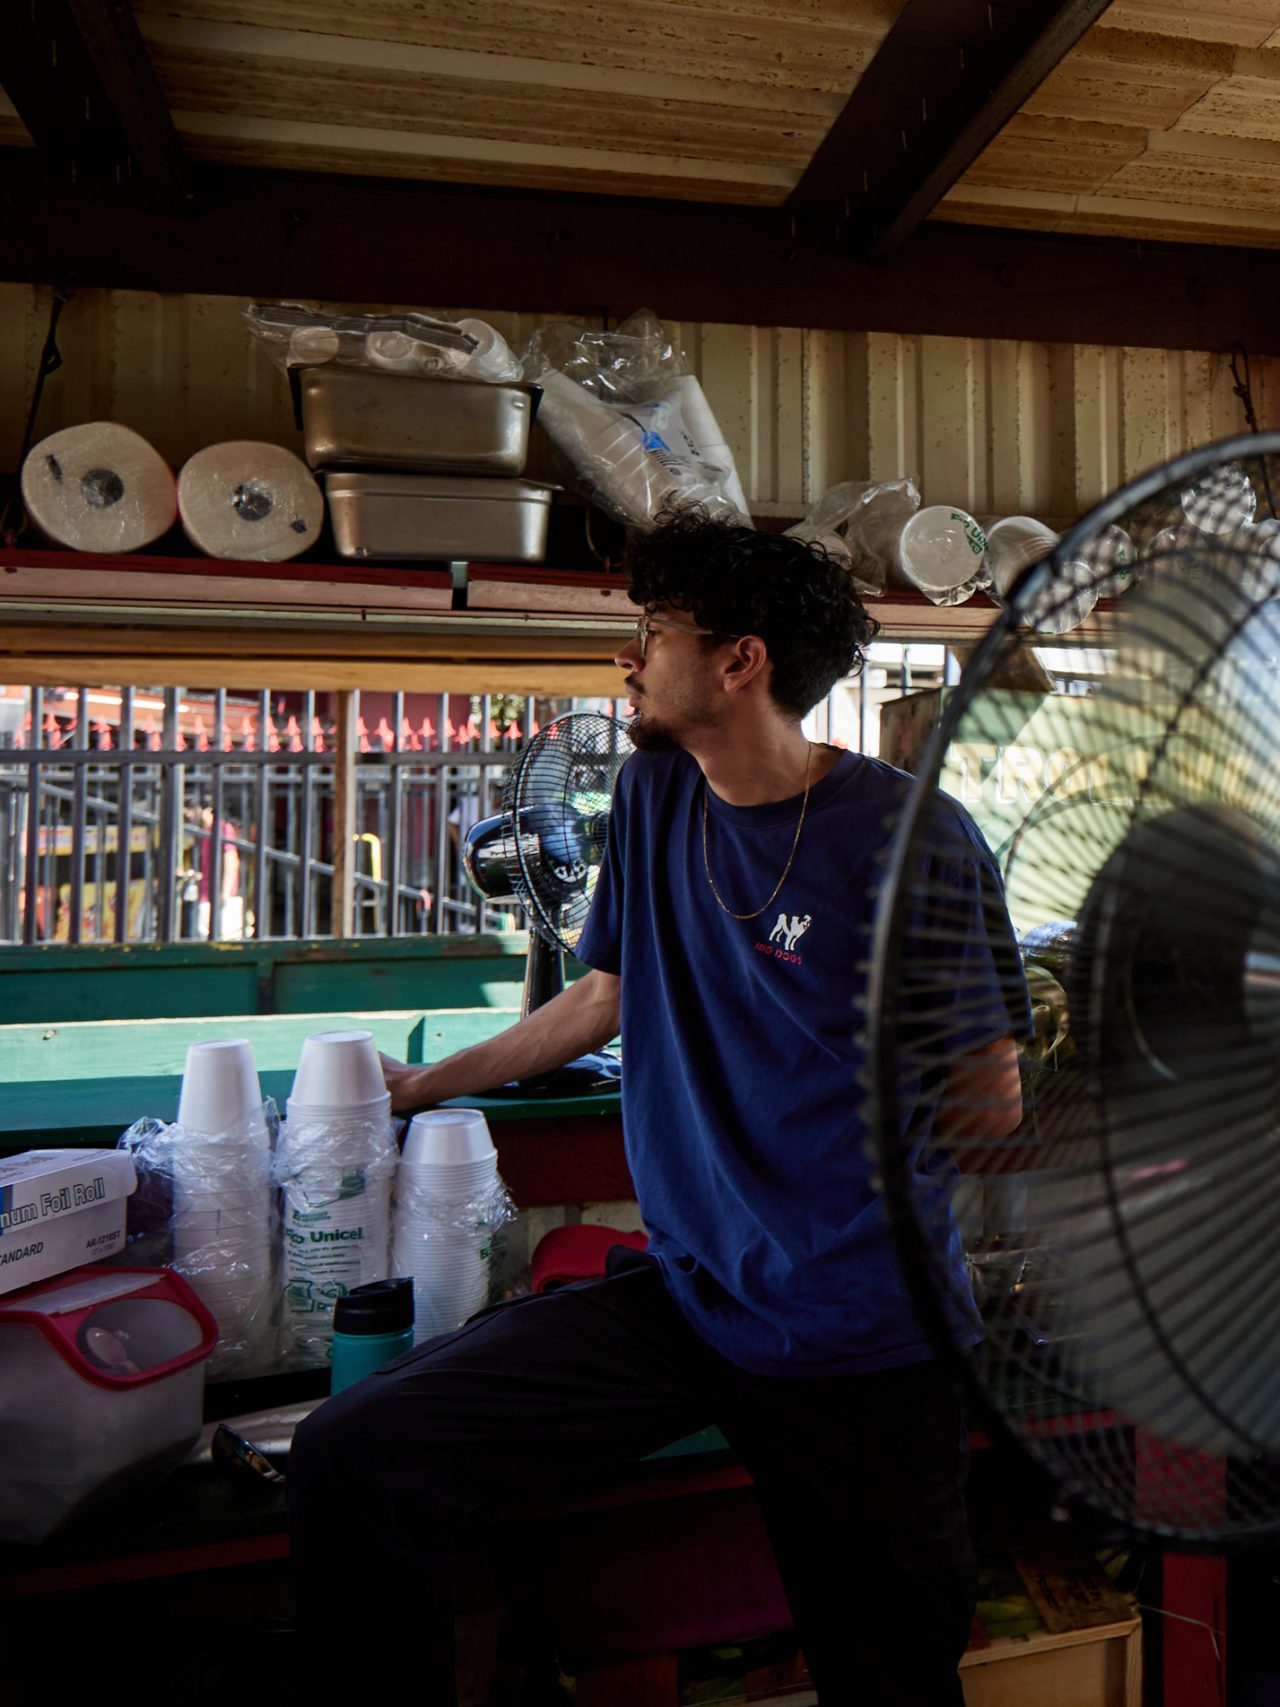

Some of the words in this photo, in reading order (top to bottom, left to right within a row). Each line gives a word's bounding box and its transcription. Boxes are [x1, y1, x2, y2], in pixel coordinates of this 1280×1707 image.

[775, 949, 802, 965] DOGS
[40, 1187, 71, 1216] Foil
[73, 1177, 106, 1206] Roll
[310, 1227, 363, 1242] Unicel
